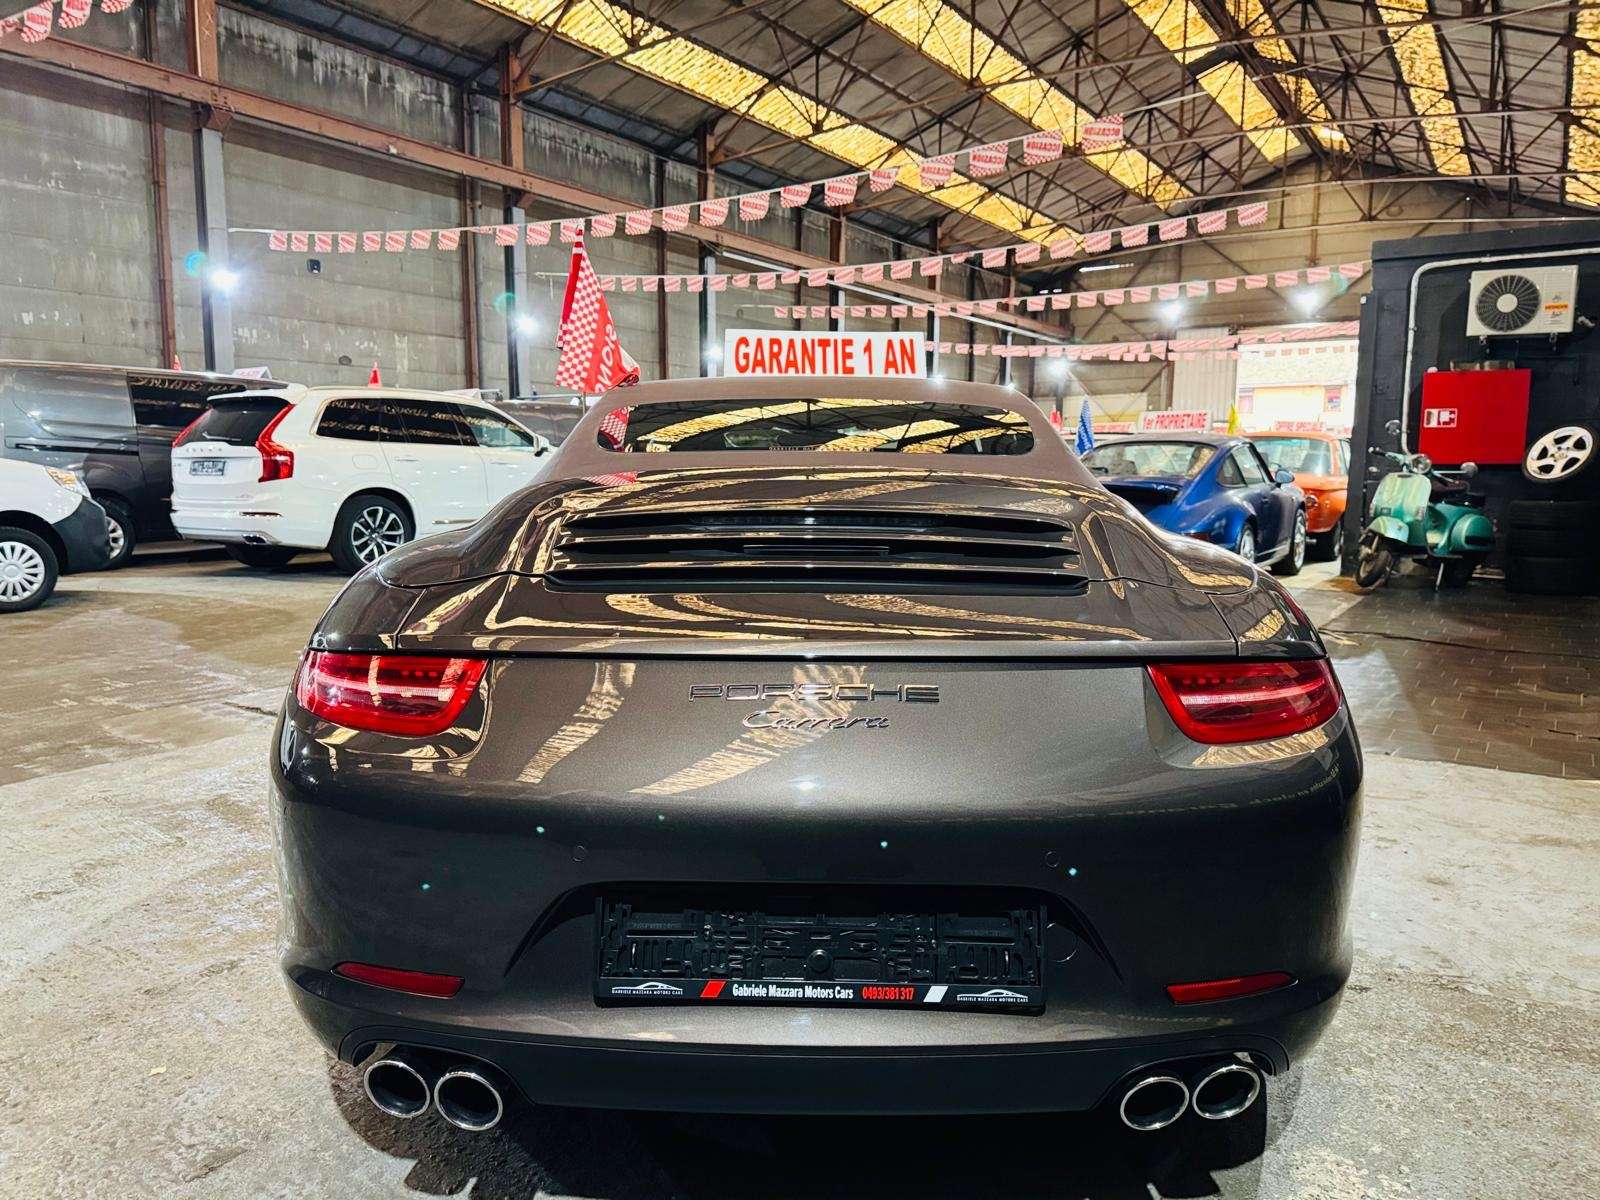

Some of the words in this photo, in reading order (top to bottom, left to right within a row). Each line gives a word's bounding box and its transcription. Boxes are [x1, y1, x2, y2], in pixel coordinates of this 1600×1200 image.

[734, 336, 855, 375] GARANTIE
[863, 338, 874, 374] 1
[884, 338, 916, 374] AN
[689, 683, 939, 702] PORSCHE
[742, 711, 890, 729] Carrera
[732, 984, 767, 997] Gabriele
[768, 984, 803, 998] Mazzara
[804, 986, 833, 999] Motors
[834, 986, 853, 999] Cars
